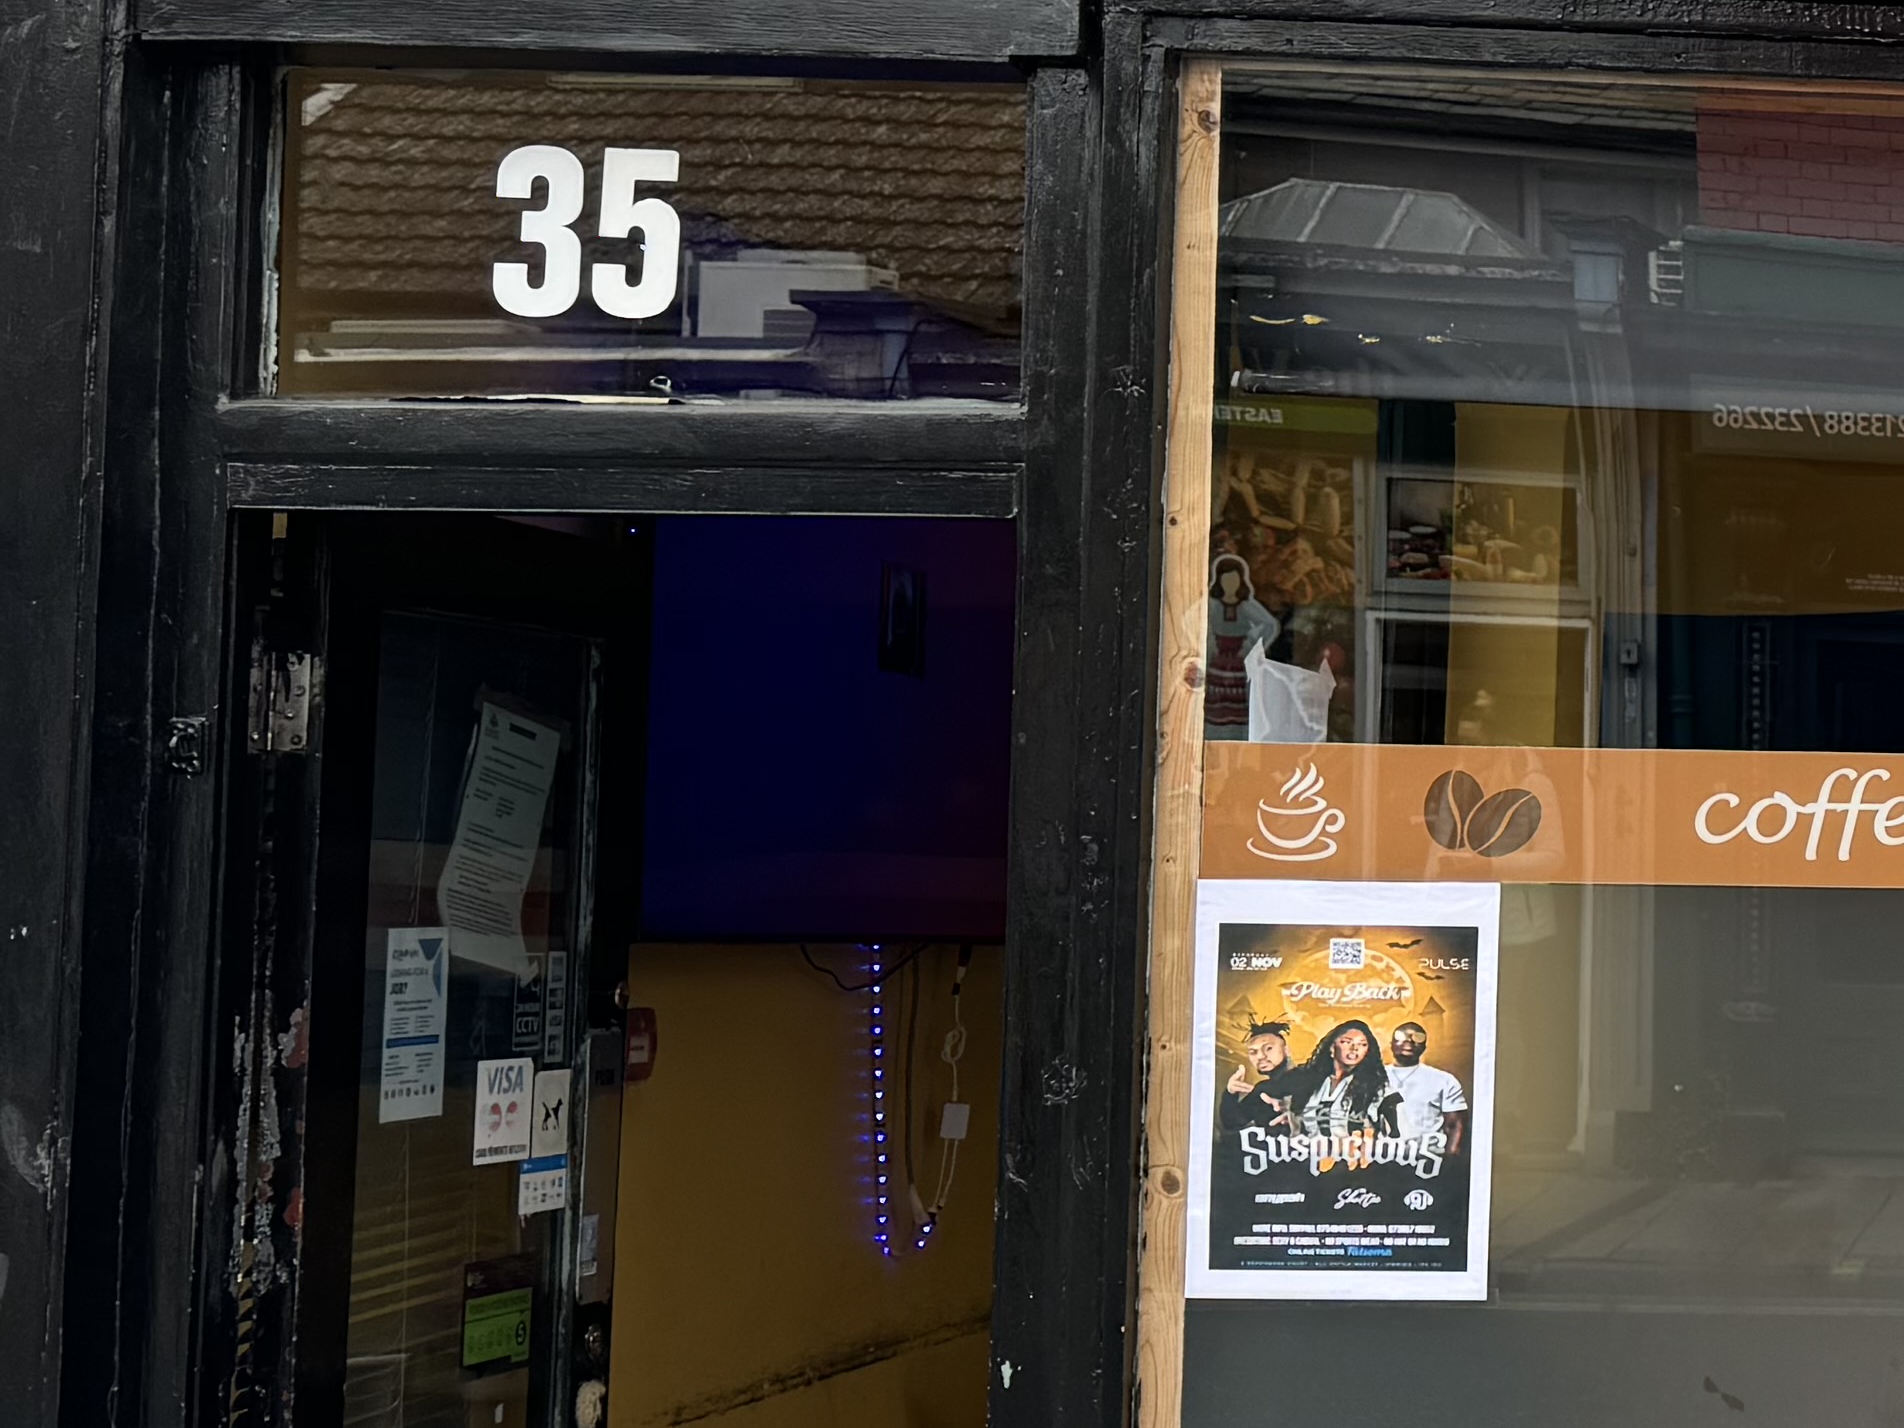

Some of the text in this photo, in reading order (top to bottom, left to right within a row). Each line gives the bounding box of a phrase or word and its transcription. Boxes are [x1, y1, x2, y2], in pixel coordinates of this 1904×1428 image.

[492, 145, 681, 318] 35
[1418, 958, 1470, 970] PULSE
[516, 1016, 540, 1033] CCTV
[487, 1065, 524, 1095] VISA
